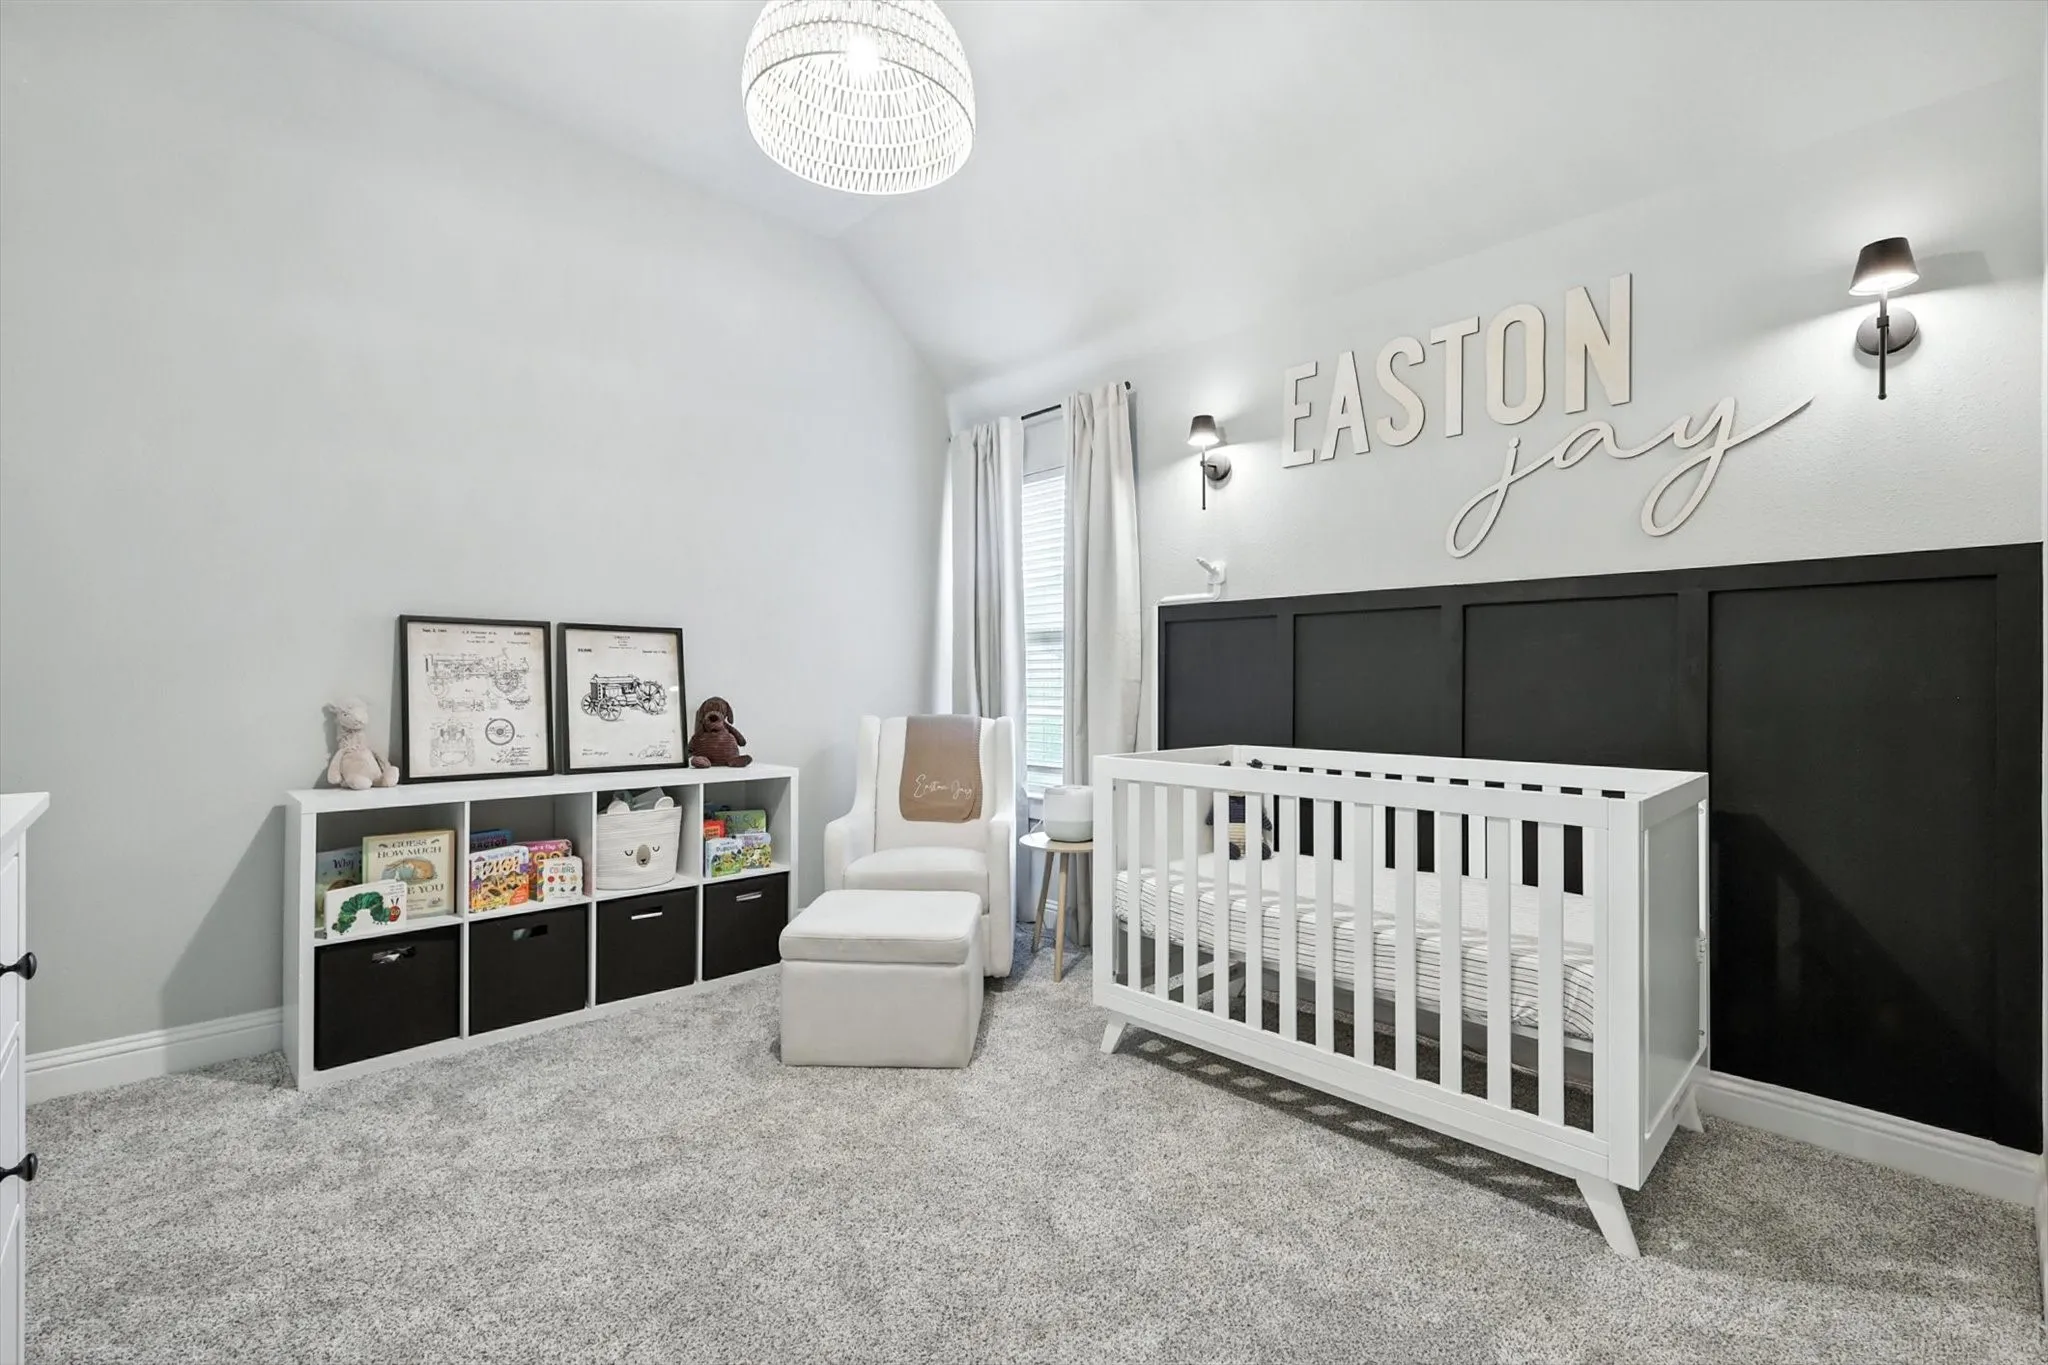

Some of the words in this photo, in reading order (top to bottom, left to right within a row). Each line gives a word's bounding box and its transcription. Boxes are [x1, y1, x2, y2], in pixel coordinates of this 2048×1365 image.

[1282, 272, 1633, 468] EASTON
[914, 774, 949, 798] Easton
[951, 780, 972, 800] Jay
[392, 839, 427, 849] GUESS
[377, 849, 405, 859] HOW
[407, 846, 442, 856] MUCH
[418, 883, 444, 894] YOU
